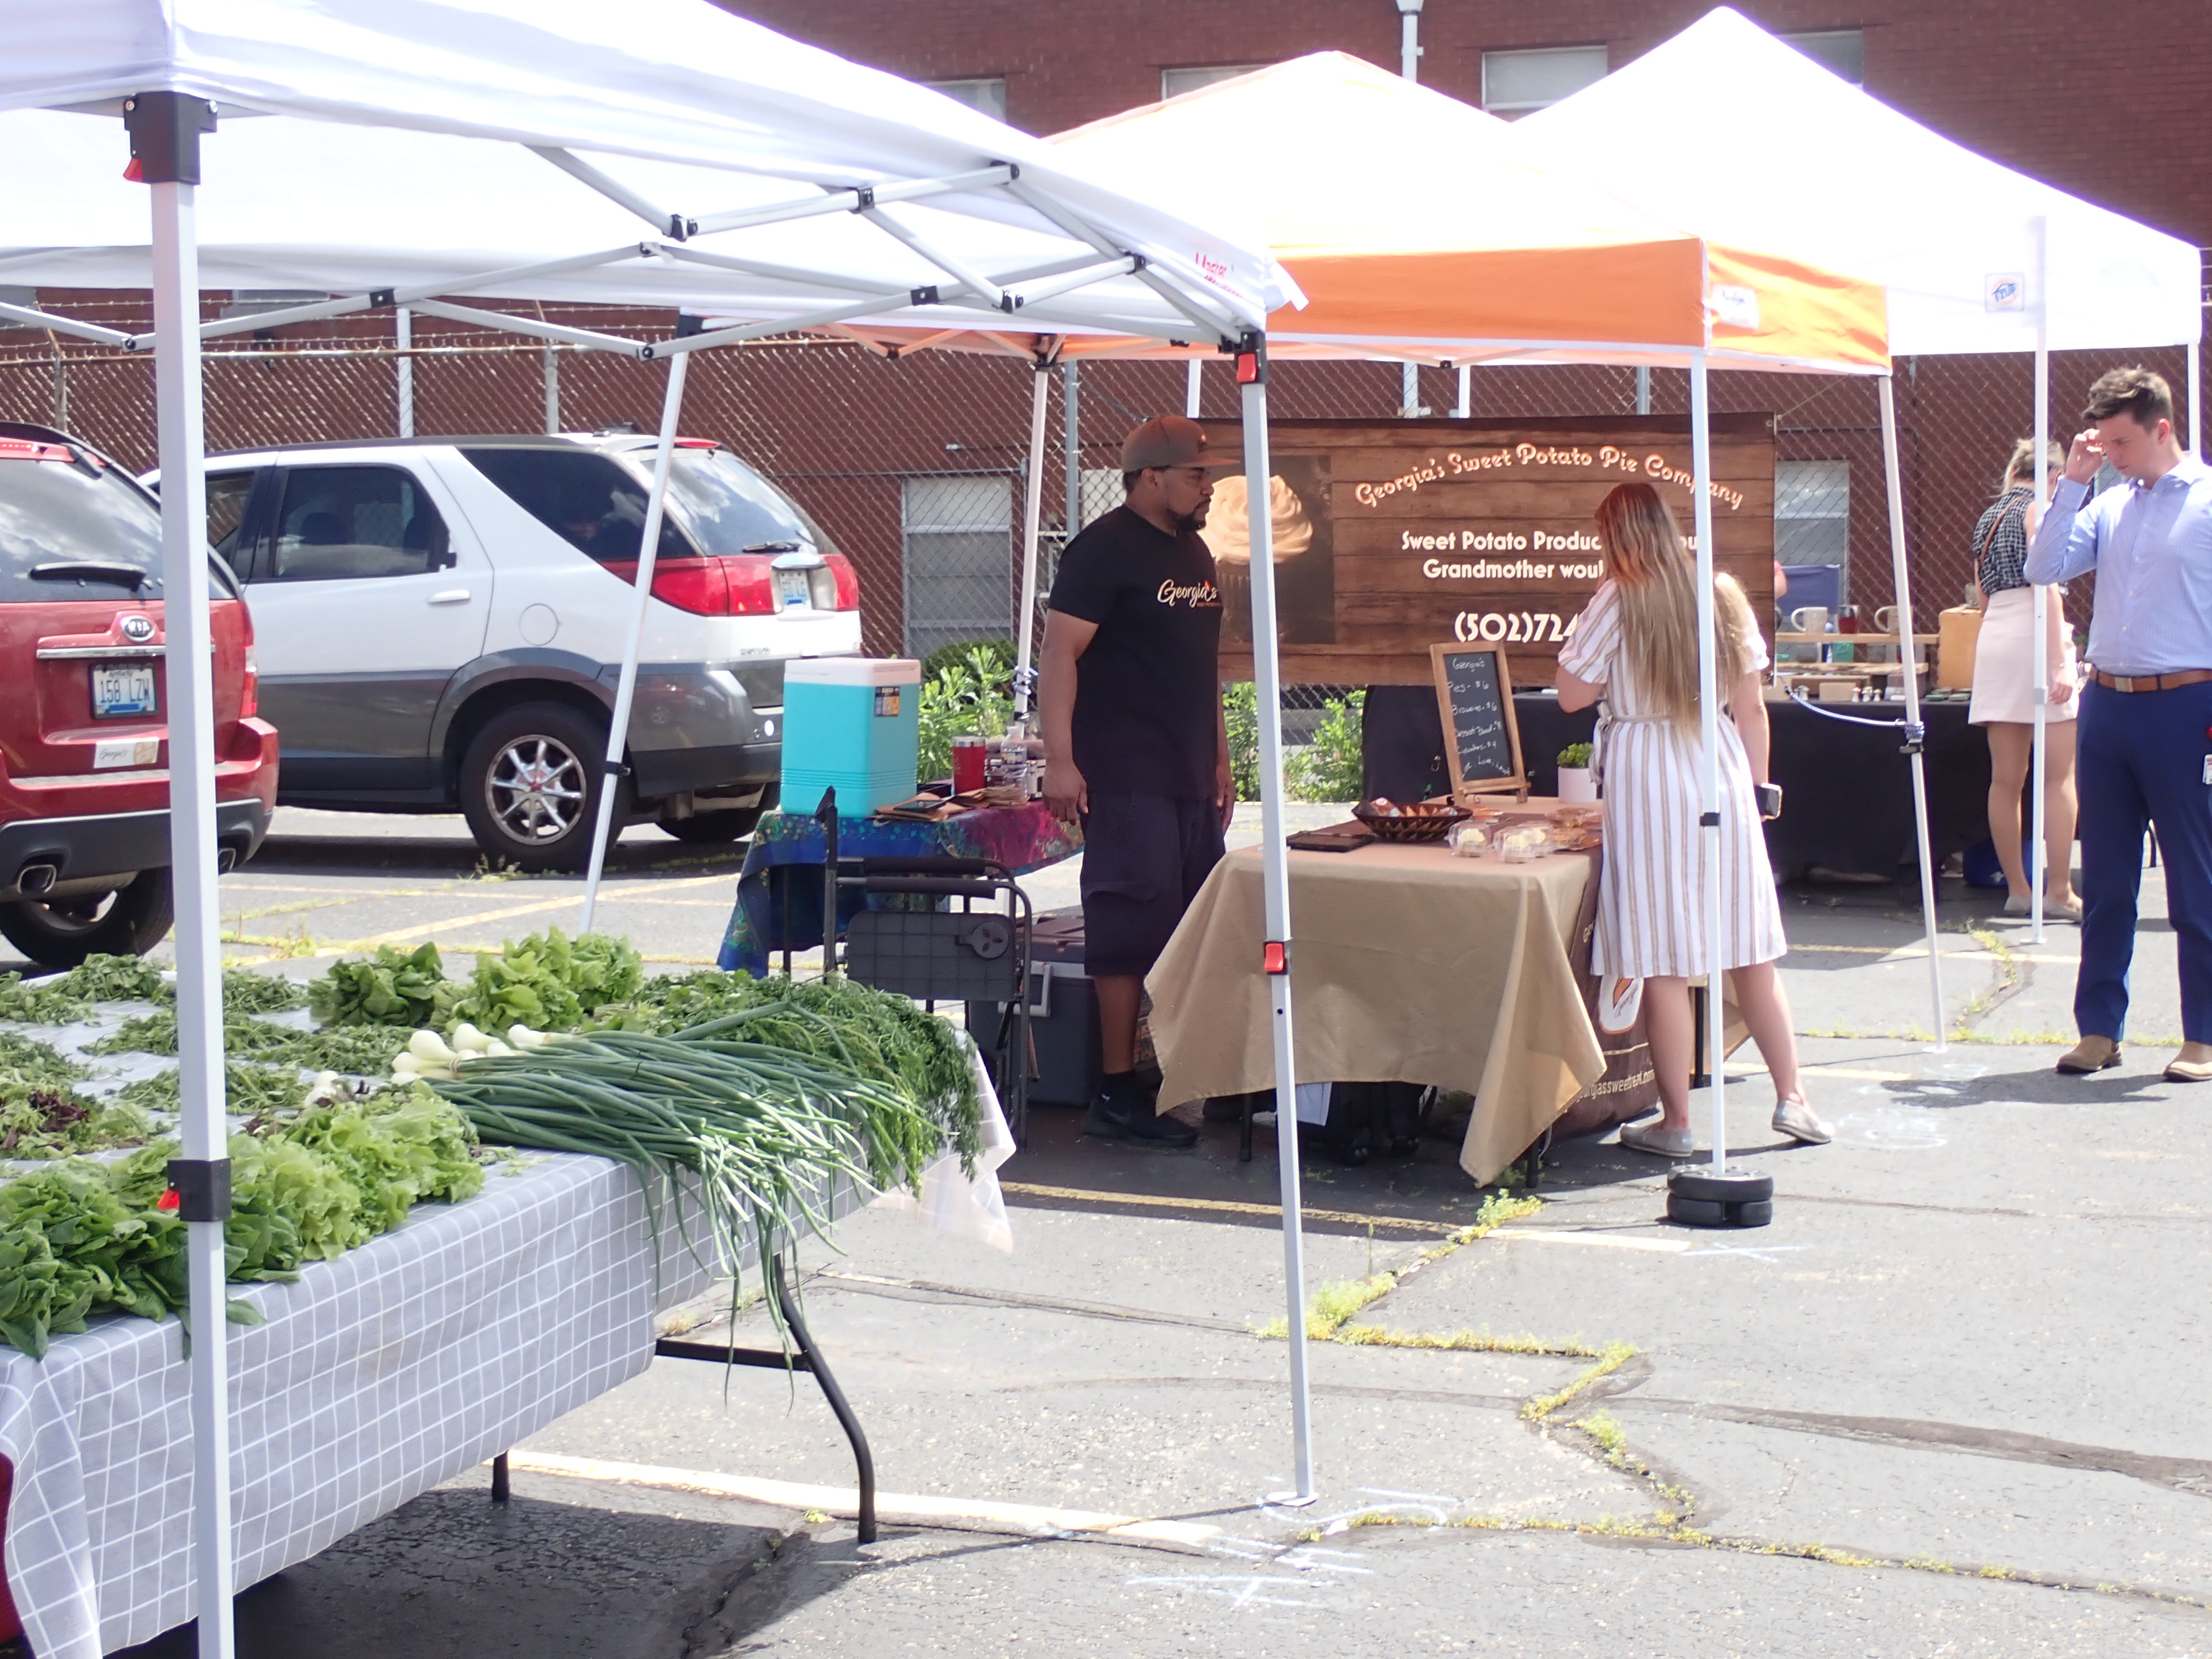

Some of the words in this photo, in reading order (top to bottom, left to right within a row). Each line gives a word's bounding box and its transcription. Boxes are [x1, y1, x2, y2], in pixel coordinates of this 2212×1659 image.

[1355, 458, 1445, 508] Georgia's
[1447, 447, 1512, 474] Sweet
[1515, 442, 1593, 465] Potato
[1599, 445, 1638, 472] Pie
[1402, 531, 1456, 550] Sweet
[1462, 531, 1527, 550] Potato
[1533, 531, 1601, 550] Produc
[1423, 559, 1554, 578] Grandmother
[1559, 559, 1604, 578] woul
[1157, 578, 1218, 608] Georgia's
[1454, 611, 1578, 643] (502)724
[100, 680, 121, 703] 158
